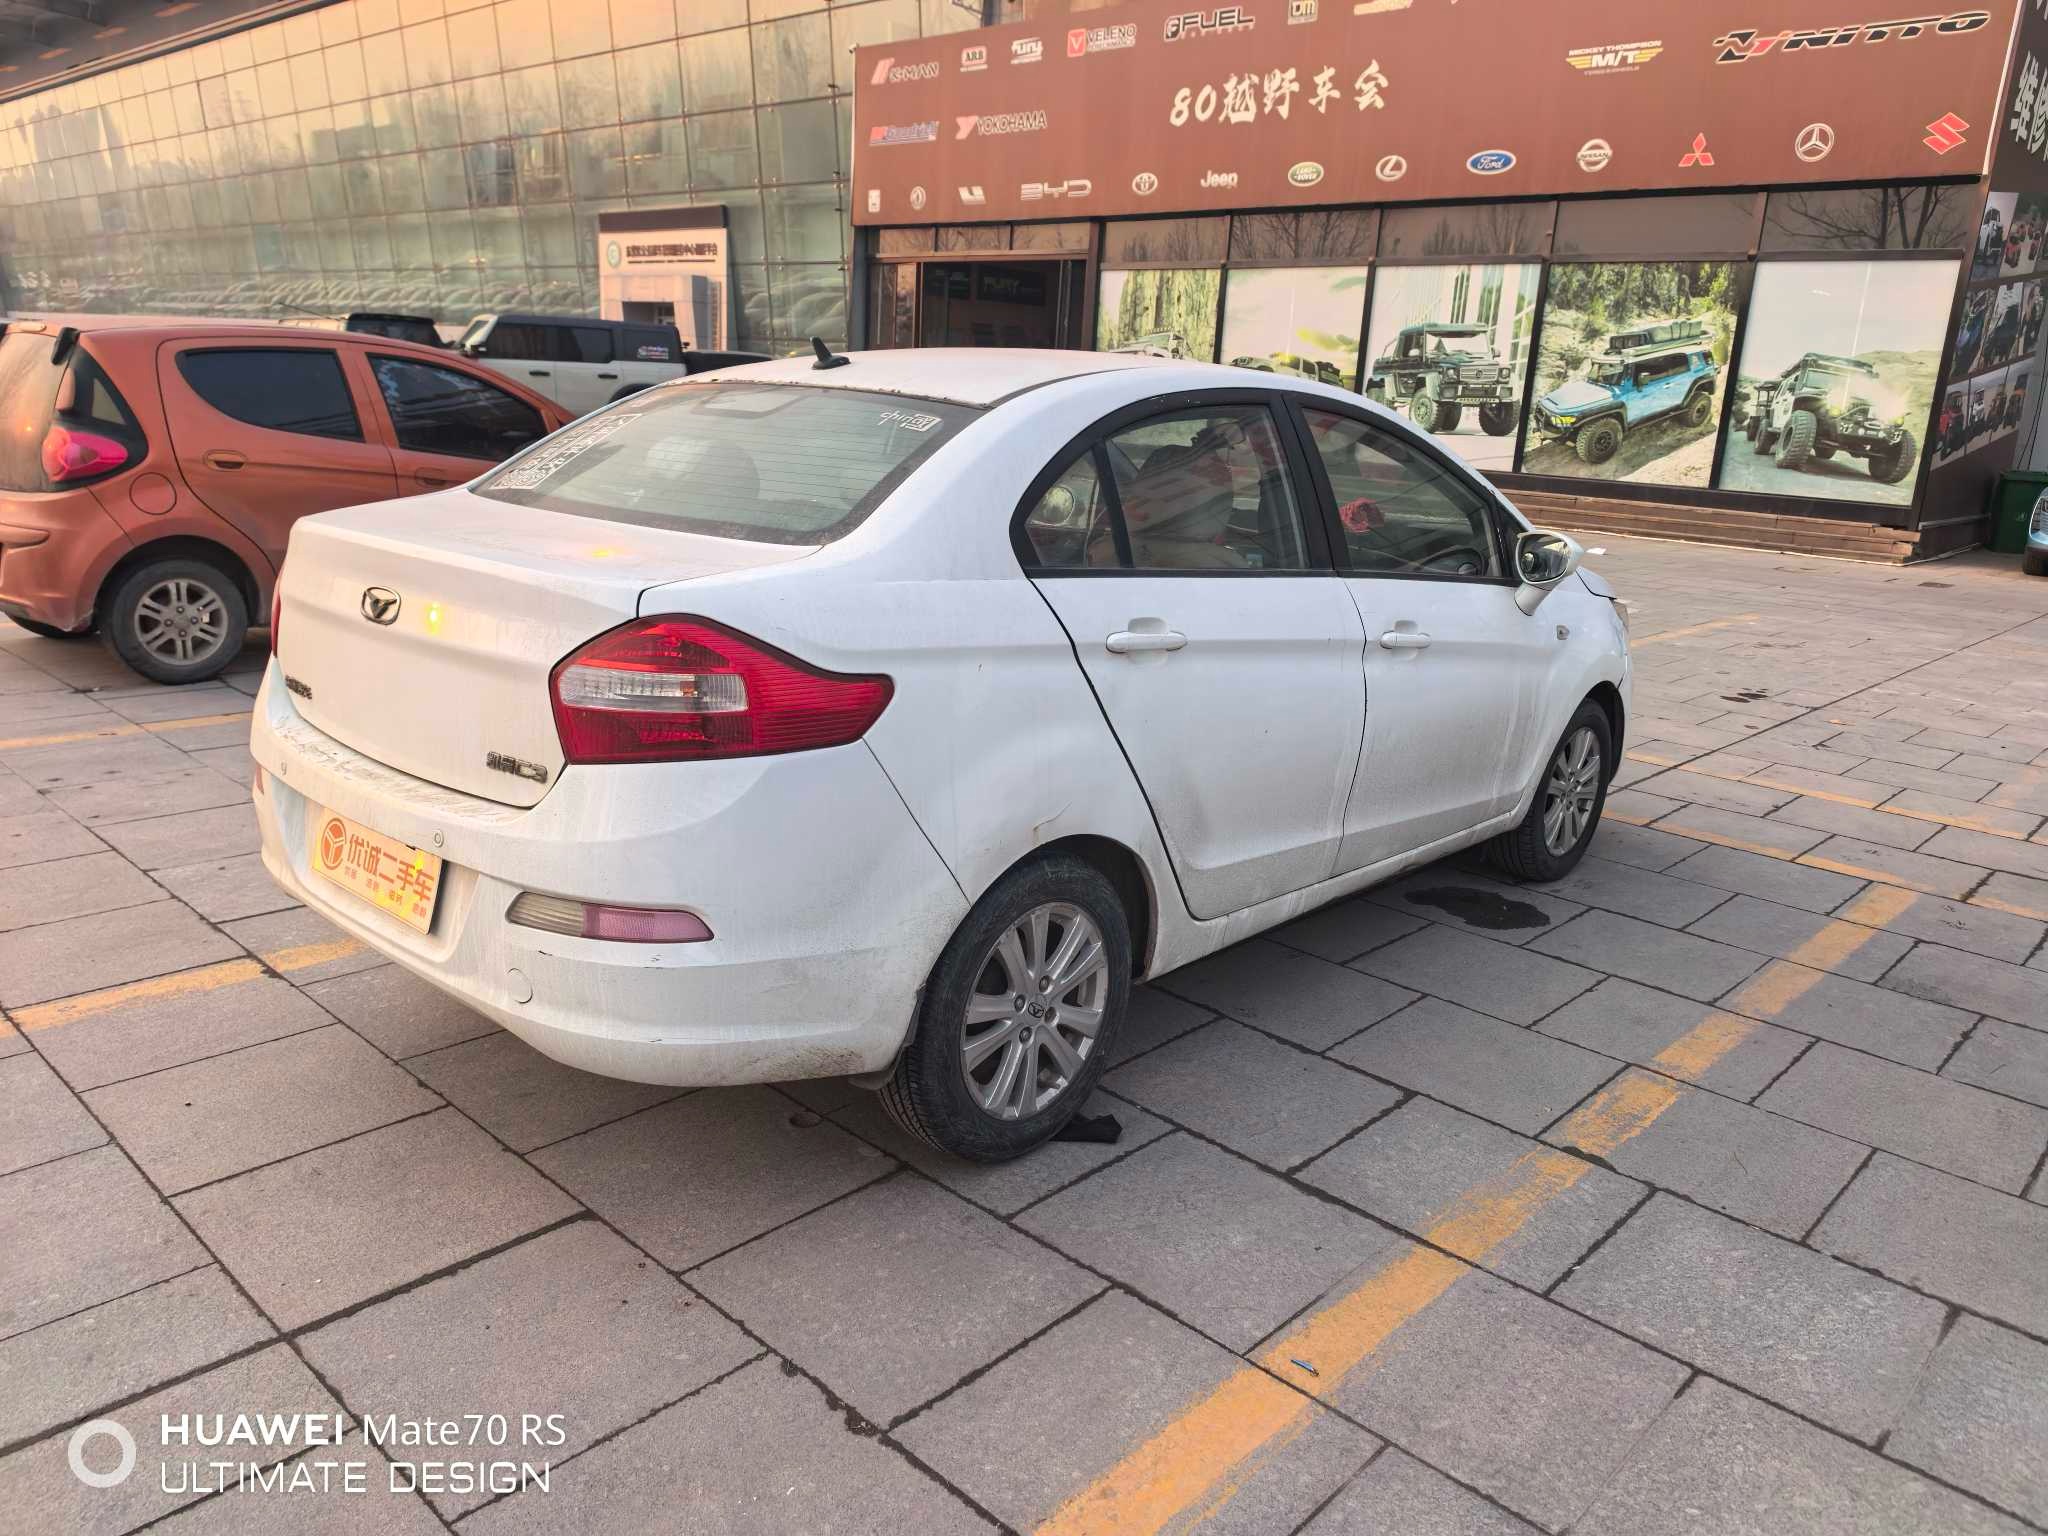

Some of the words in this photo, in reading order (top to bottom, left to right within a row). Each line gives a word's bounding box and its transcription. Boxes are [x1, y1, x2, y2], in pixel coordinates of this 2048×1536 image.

[1182, 7, 1255, 32] FUEL
[1087, 24, 1137, 43] VELENO
[1782, 11, 1990, 51] NITTO
[1591, 51, 1640, 67] M/T
[977, 110, 1048, 135] YOKOHAMA
[1476, 156, 1505, 170] Ford
[1020, 179, 1092, 201] BYD
[1201, 170, 1238, 189] Jeep
[347, 834, 435, 901] 优诚二手车
